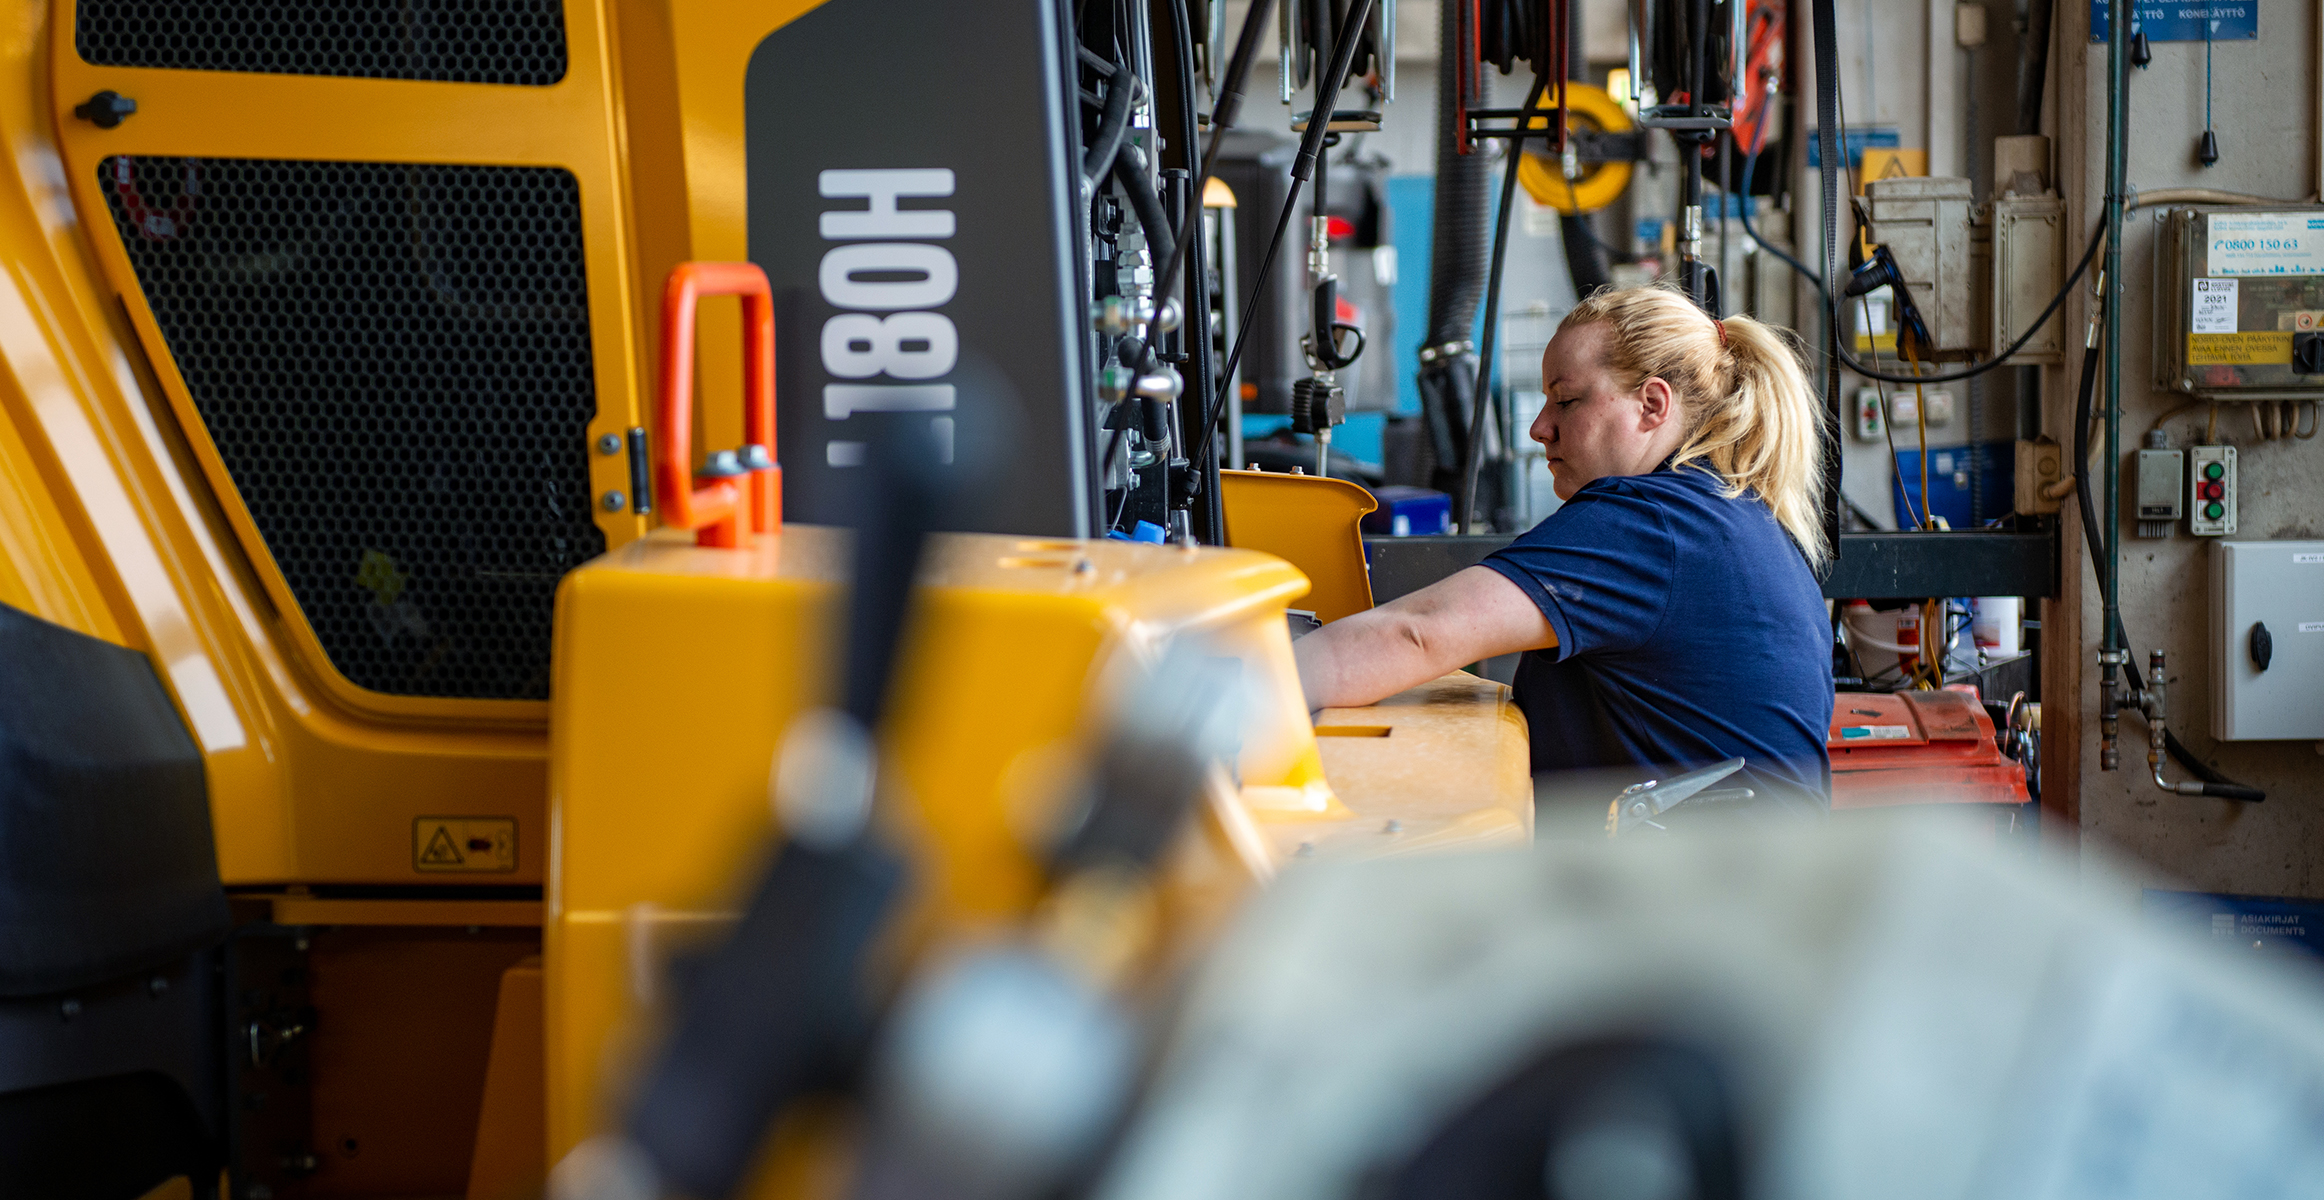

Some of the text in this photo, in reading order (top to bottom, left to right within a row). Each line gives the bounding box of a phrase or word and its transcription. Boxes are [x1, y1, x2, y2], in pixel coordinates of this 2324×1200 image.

[2225, 238, 2298, 251] 0800 150 63
[2204, 294, 2227, 304] 2021
[2240, 914, 2300, 924] ASIAKIRJAT
[2241, 926, 2306, 936] DOCUMENTS
